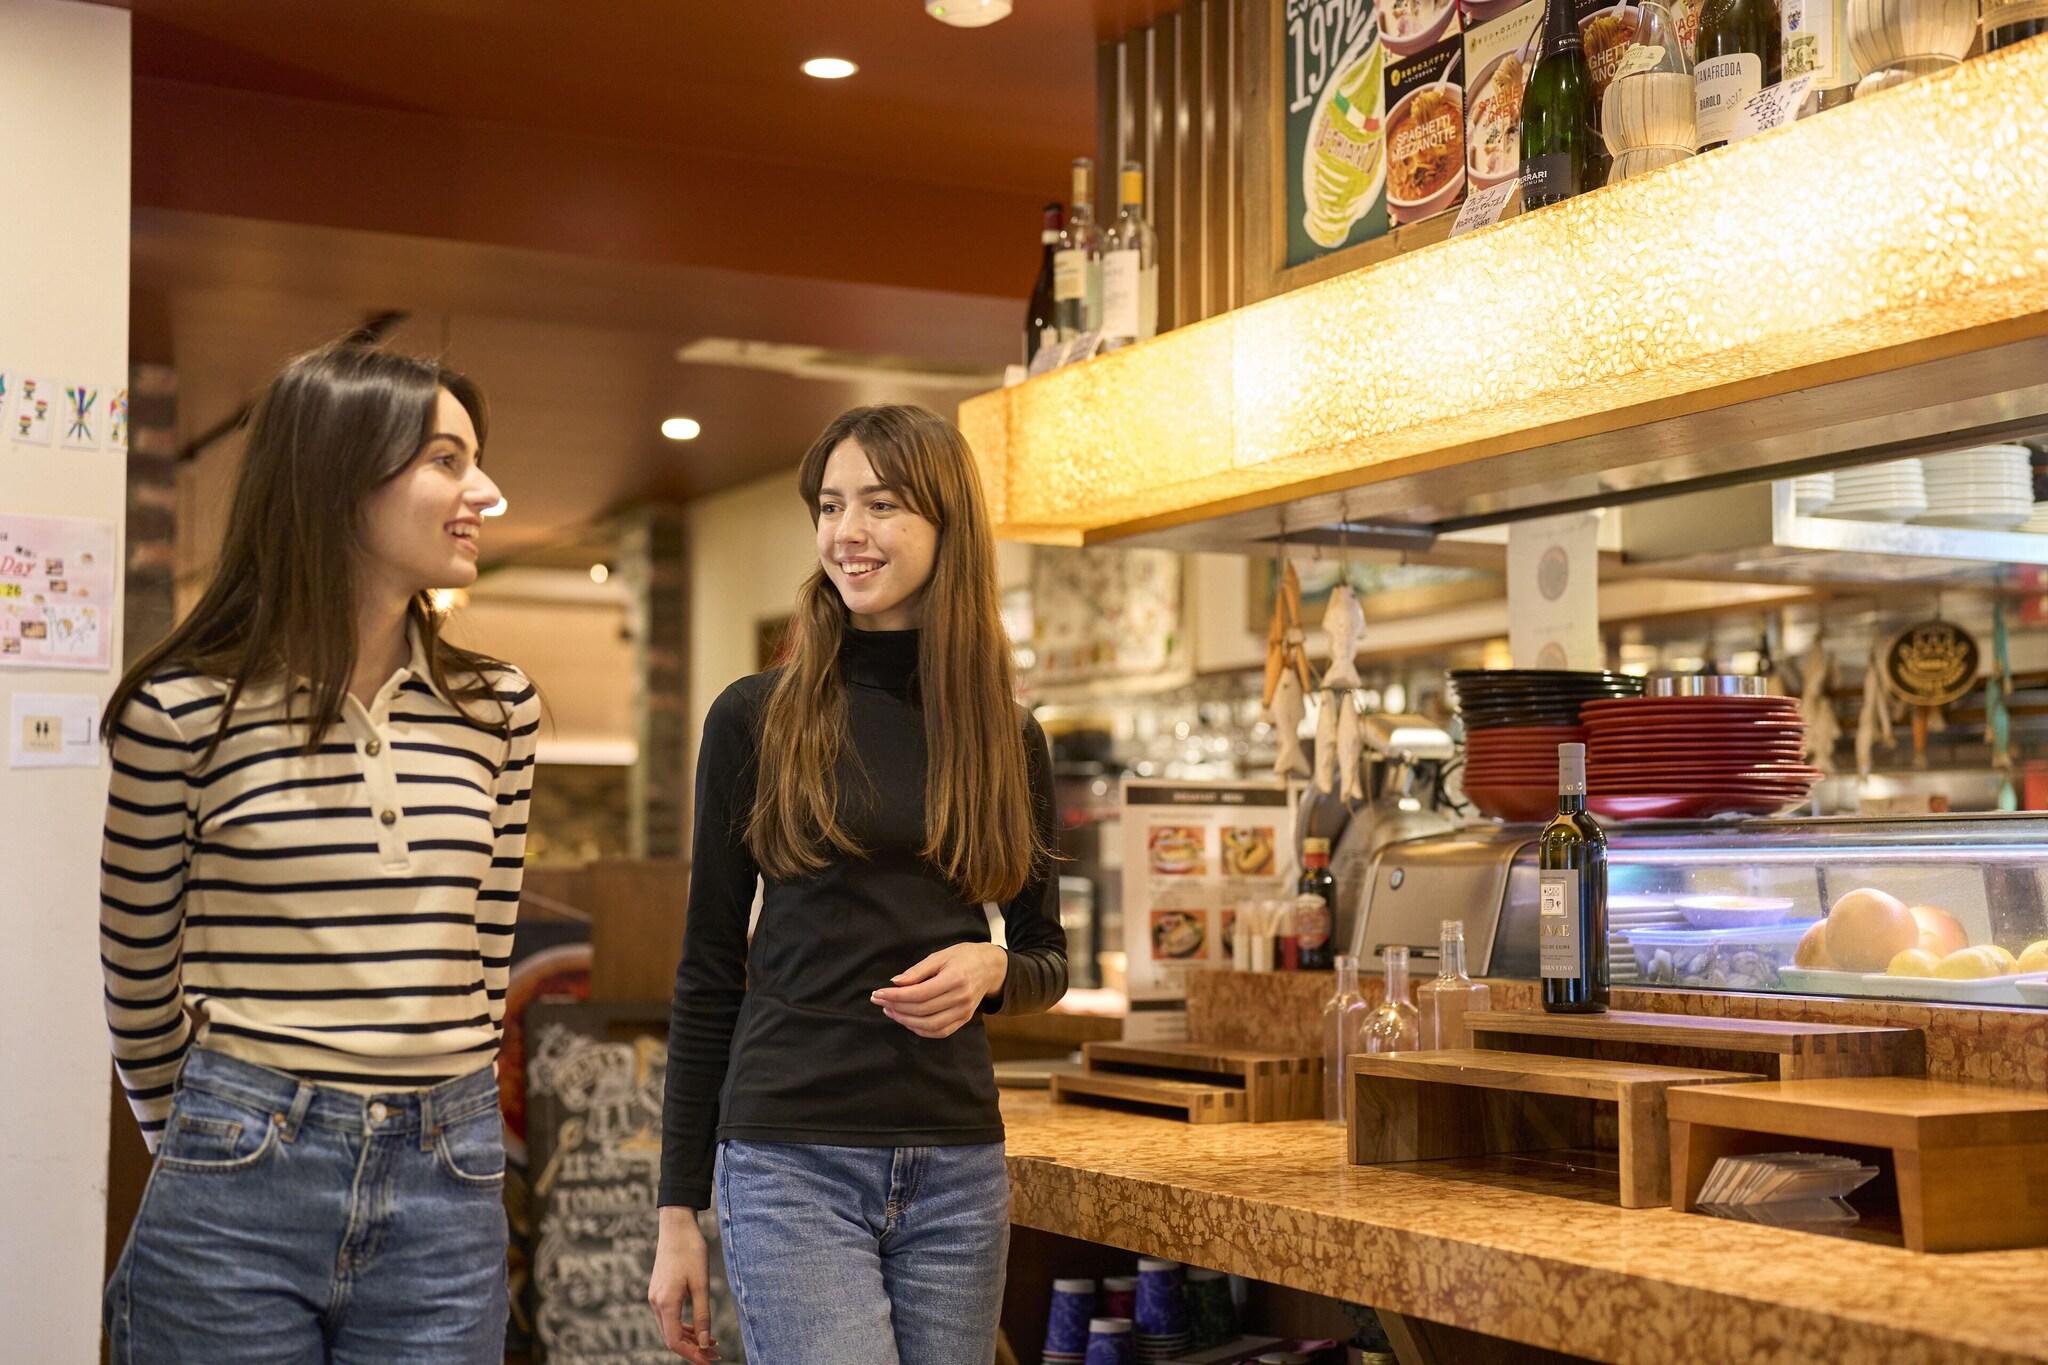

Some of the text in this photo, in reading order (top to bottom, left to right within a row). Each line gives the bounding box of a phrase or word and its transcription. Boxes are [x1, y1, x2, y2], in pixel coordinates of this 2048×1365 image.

[1699, 93, 1721, 111] BAROLO
[1396, 114, 1452, 146] SPAGHETTI
[0, 555, 37, 577] Day
